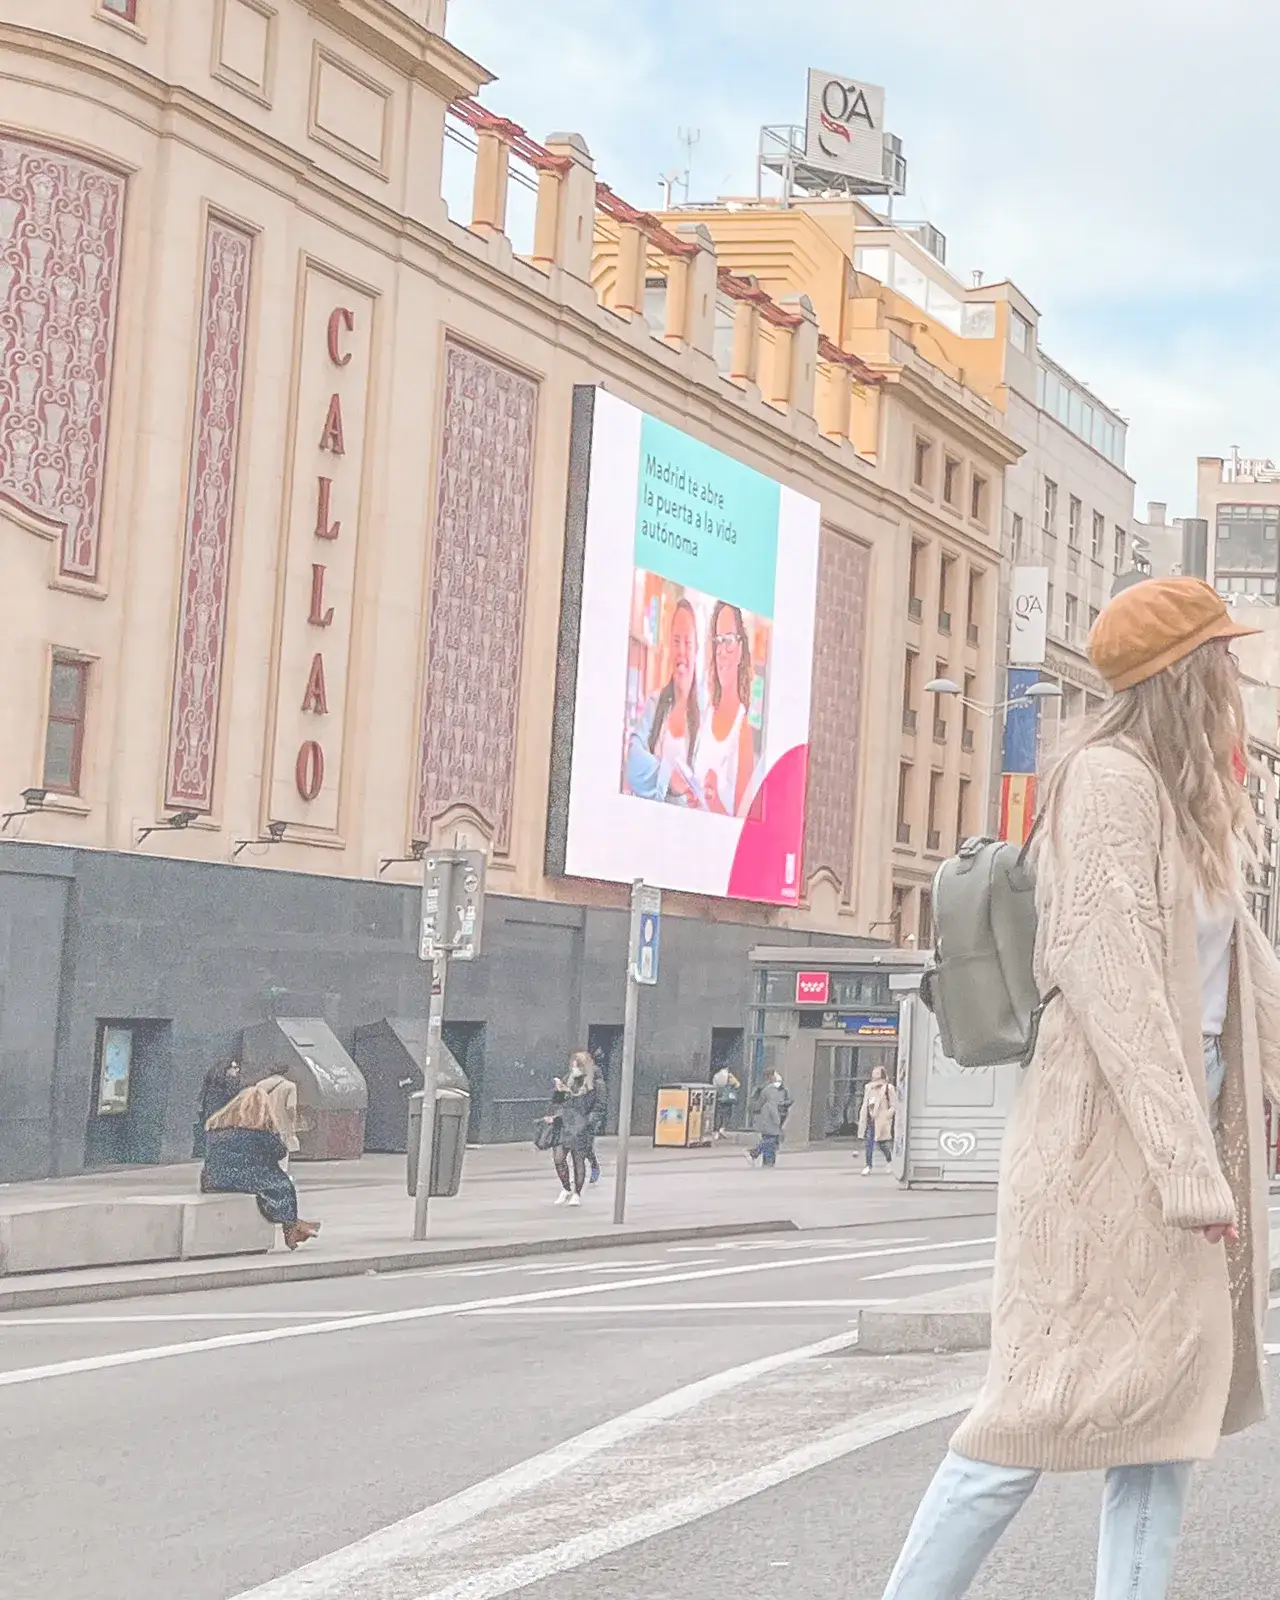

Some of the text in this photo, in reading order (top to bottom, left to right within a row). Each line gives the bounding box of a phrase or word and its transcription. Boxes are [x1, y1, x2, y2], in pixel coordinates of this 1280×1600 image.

[645, 453, 724, 510] Madrid te abre
[641, 519, 698, 557] autónoma
[643, 482, 737, 545] la puerta a la vida
[295, 306, 355, 801] CALLAO
